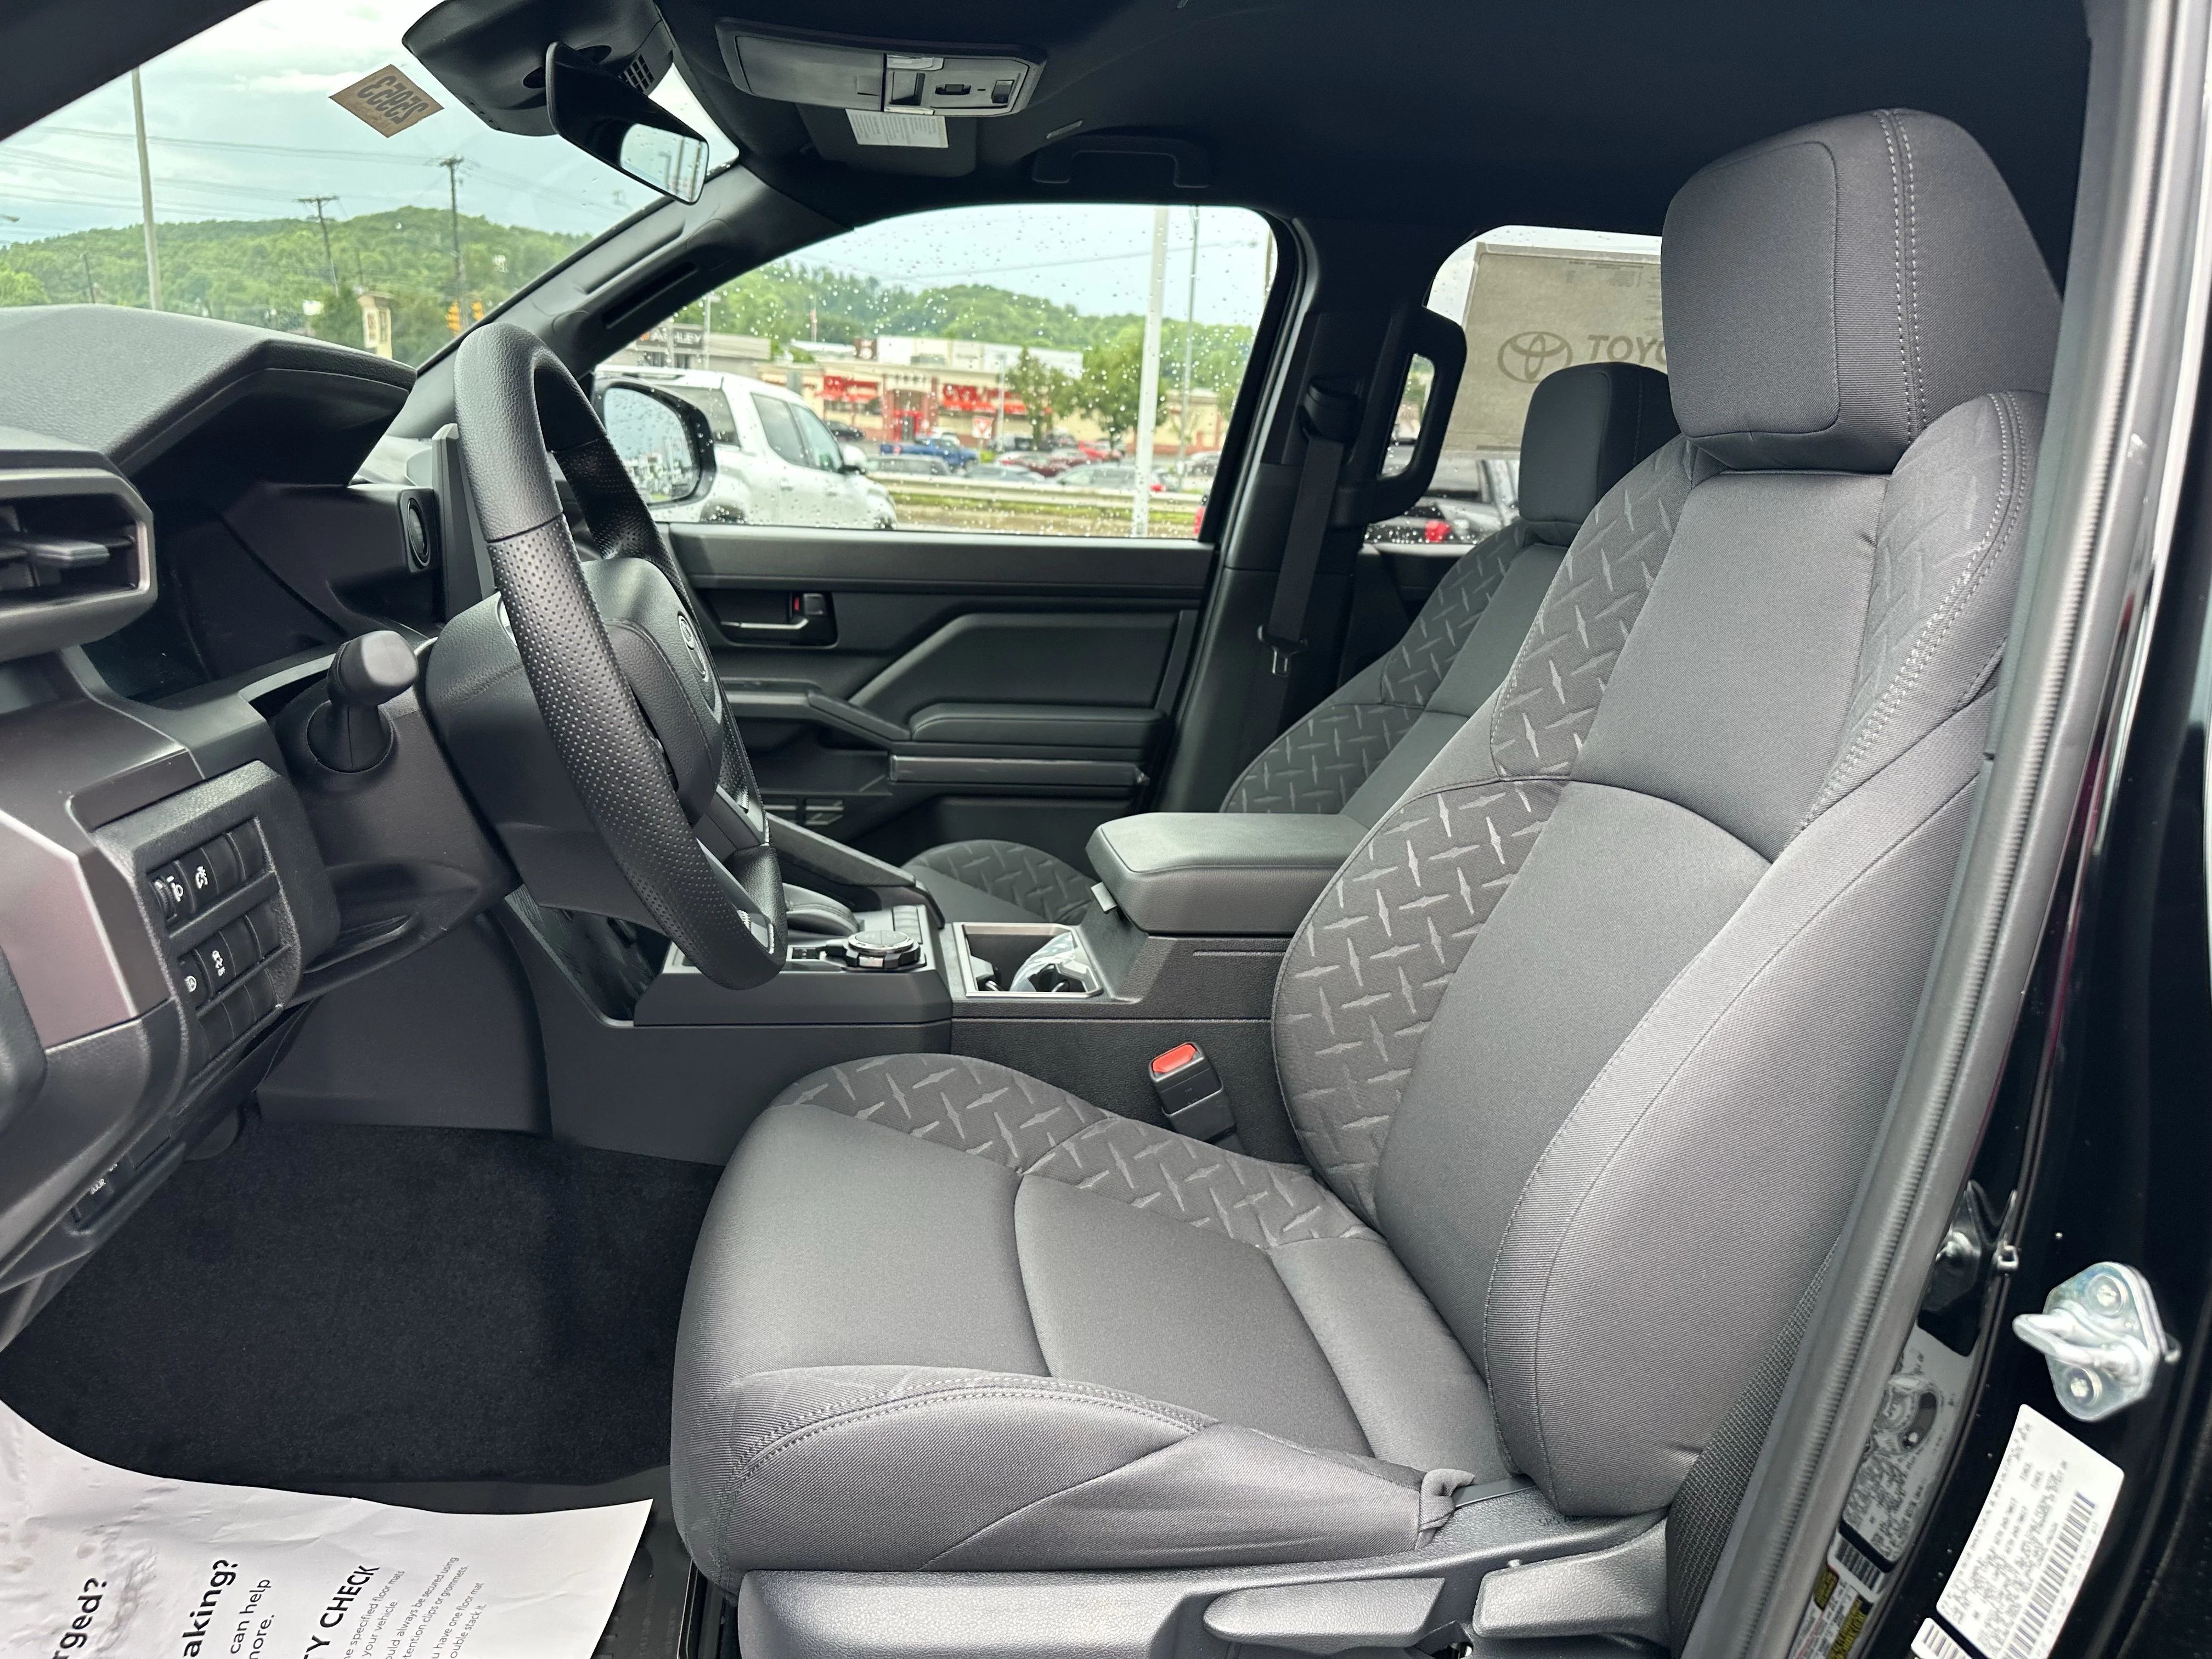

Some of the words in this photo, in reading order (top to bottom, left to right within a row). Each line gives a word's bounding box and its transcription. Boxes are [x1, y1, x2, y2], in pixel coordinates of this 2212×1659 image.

[182, 1559, 238, 1657] aking?
[239, 1579, 272, 1615] help
[320, 1565, 380, 1628] CHECK
[350, 1604, 379, 1645] specified
[372, 1585, 391, 1601] floor
[388, 1571, 405, 1584] mats
[397, 1609, 418, 1636] always
[411, 1598, 426, 1607] be
[422, 1574, 444, 1597] secured
[441, 1557, 459, 1573] using
[422, 1606, 438, 1622] clips
[441, 1565, 469, 1596] grommets.
[433, 1628, 452, 1649] have
[449, 1612, 462, 1626] one
[456, 1595, 473, 1611] floor
[471, 1582, 484, 1594] mat
[230, 1621, 250, 1654] can
[362, 1634, 378, 1656] your
[374, 1600, 399, 1631] vehicle.
[450, 1632, 469, 1658] ouble
[465, 1611, 482, 1630] stack
